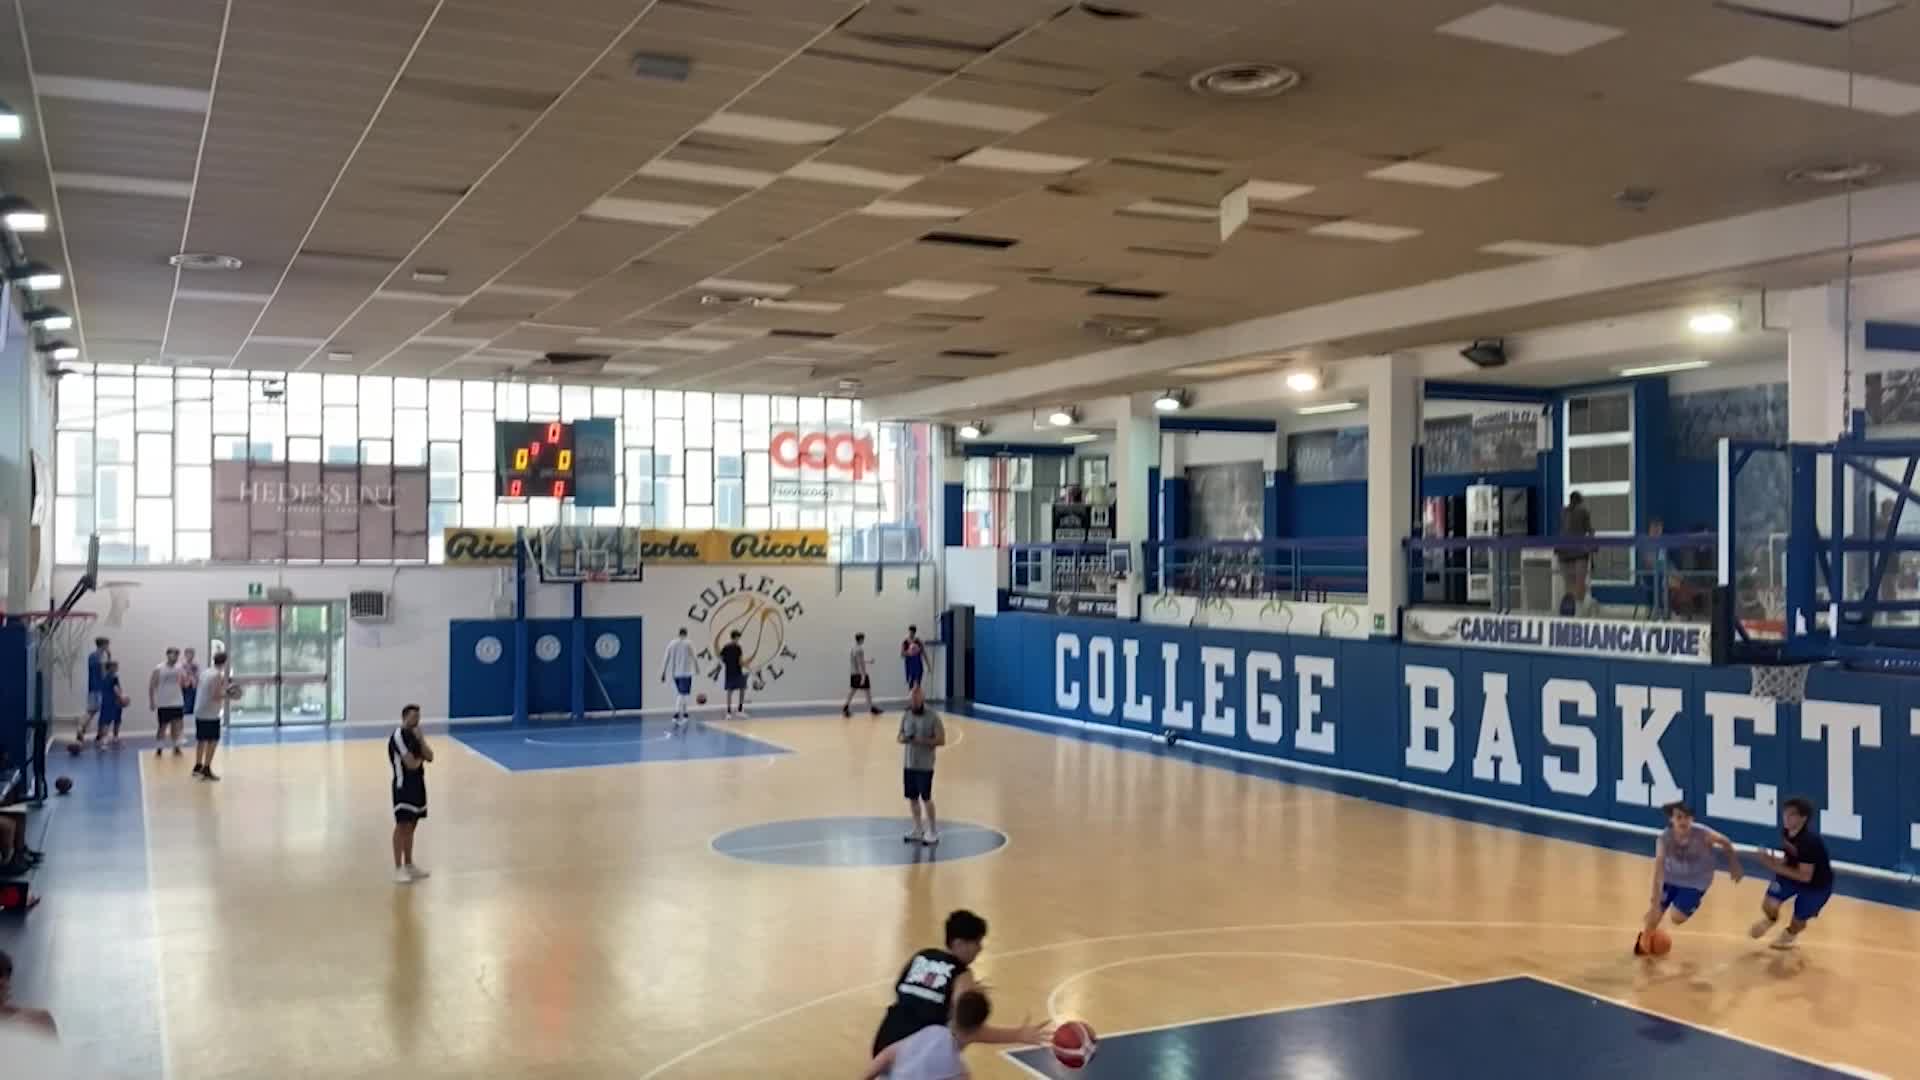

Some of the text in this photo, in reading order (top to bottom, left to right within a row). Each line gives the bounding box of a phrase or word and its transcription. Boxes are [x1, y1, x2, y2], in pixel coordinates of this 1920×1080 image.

[547, 422, 561, 444] 0
[515, 448, 528, 471] 0
[558, 449, 571, 471] 0
[641, 534, 699, 557] cola
[729, 533, 827, 559] Ricola
[688, 573, 804, 623] COLLEGE
[1460, 616, 1699, 656] CARNELLI IMBIANCATURE
[697, 646, 797, 691] FAILY
[1056, 632, 1920, 850] COLLEGE BASKET
